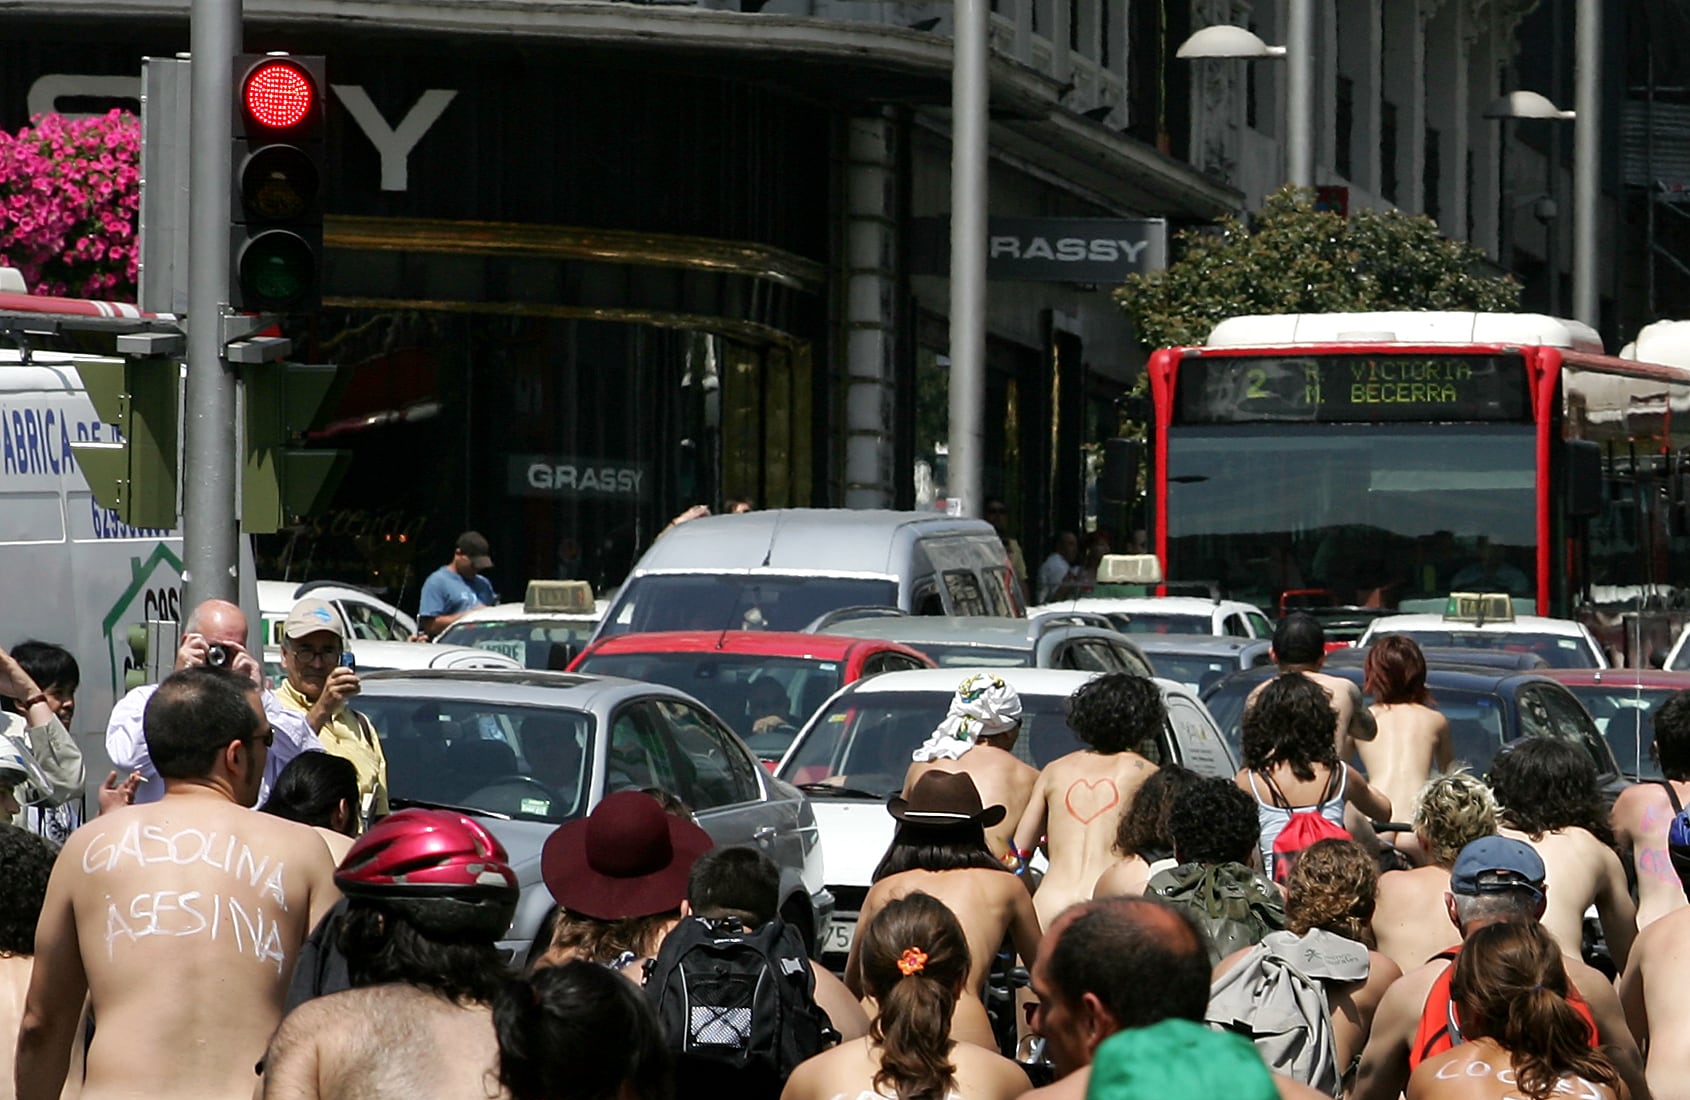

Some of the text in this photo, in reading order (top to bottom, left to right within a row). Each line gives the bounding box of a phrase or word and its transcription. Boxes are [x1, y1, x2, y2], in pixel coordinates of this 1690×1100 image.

[989, 236, 1149, 263] RASSY
[1247, 368, 1272, 399] 2
[1351, 360, 1472, 382] VICTORIA
[1351, 383, 1457, 403] BECERRA
[2, 408, 76, 476] ABRICA
[527, 463, 643, 493] GRASSY
[82, 820, 288, 912] GASOLINA
[105, 890, 285, 974] ASESINA
